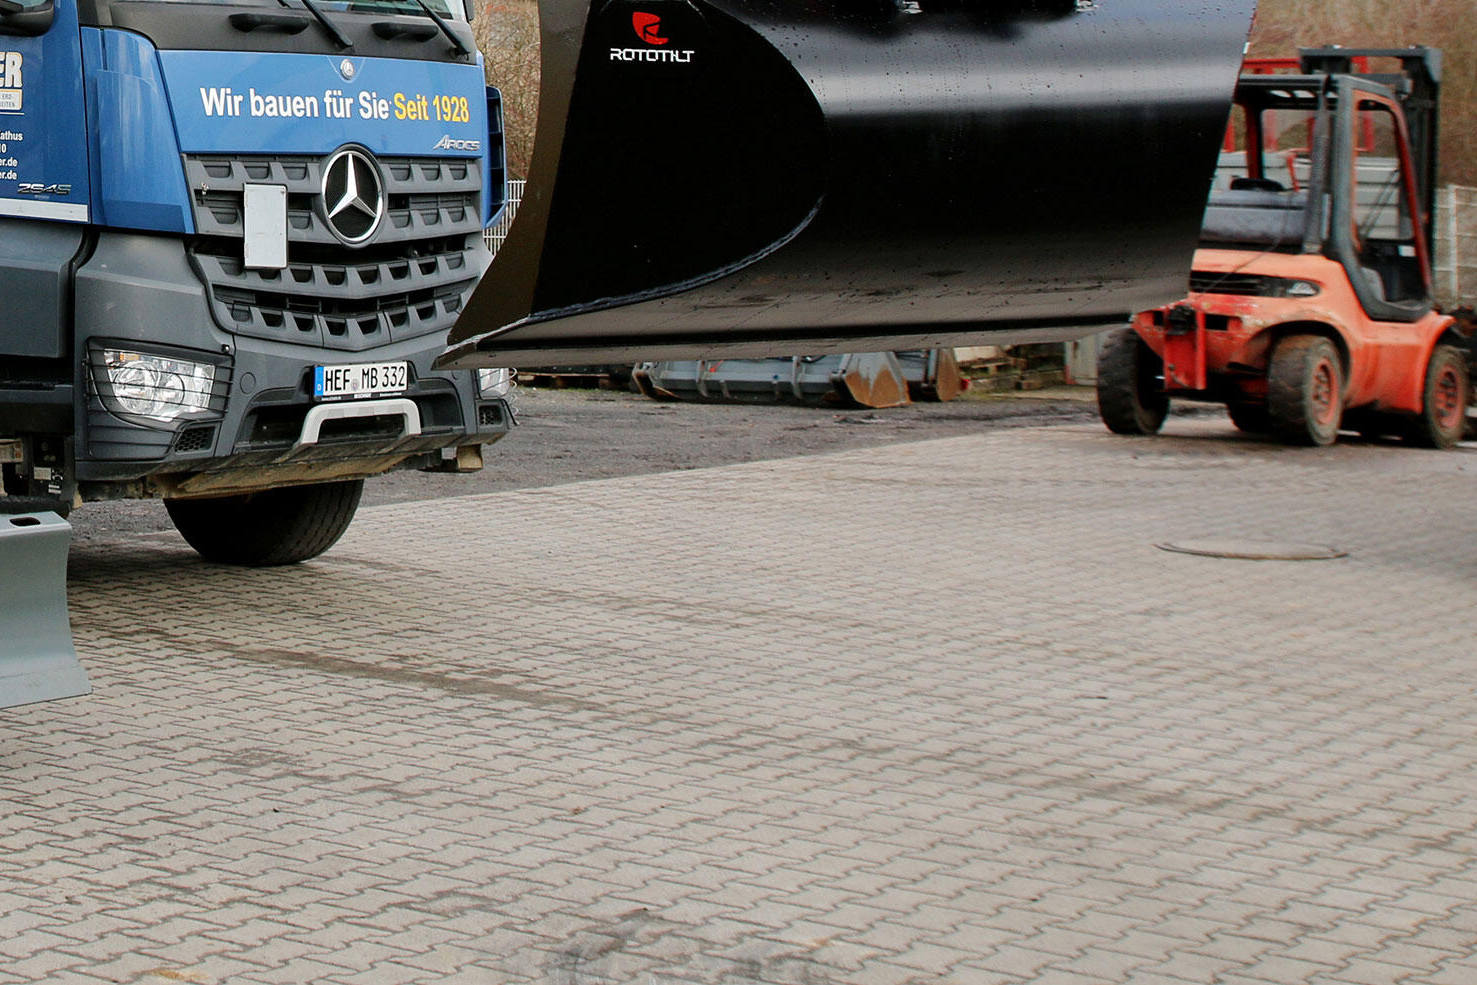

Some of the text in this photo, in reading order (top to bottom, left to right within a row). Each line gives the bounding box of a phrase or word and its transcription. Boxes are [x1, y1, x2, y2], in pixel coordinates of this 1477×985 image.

[610, 47, 695, 63] ROTOTILT
[199, 87, 470, 123] Wir bauen für Sie Seit 1928
[17, 183, 72, 196] 2645
[325, 366, 405, 392] HEF MB 332
